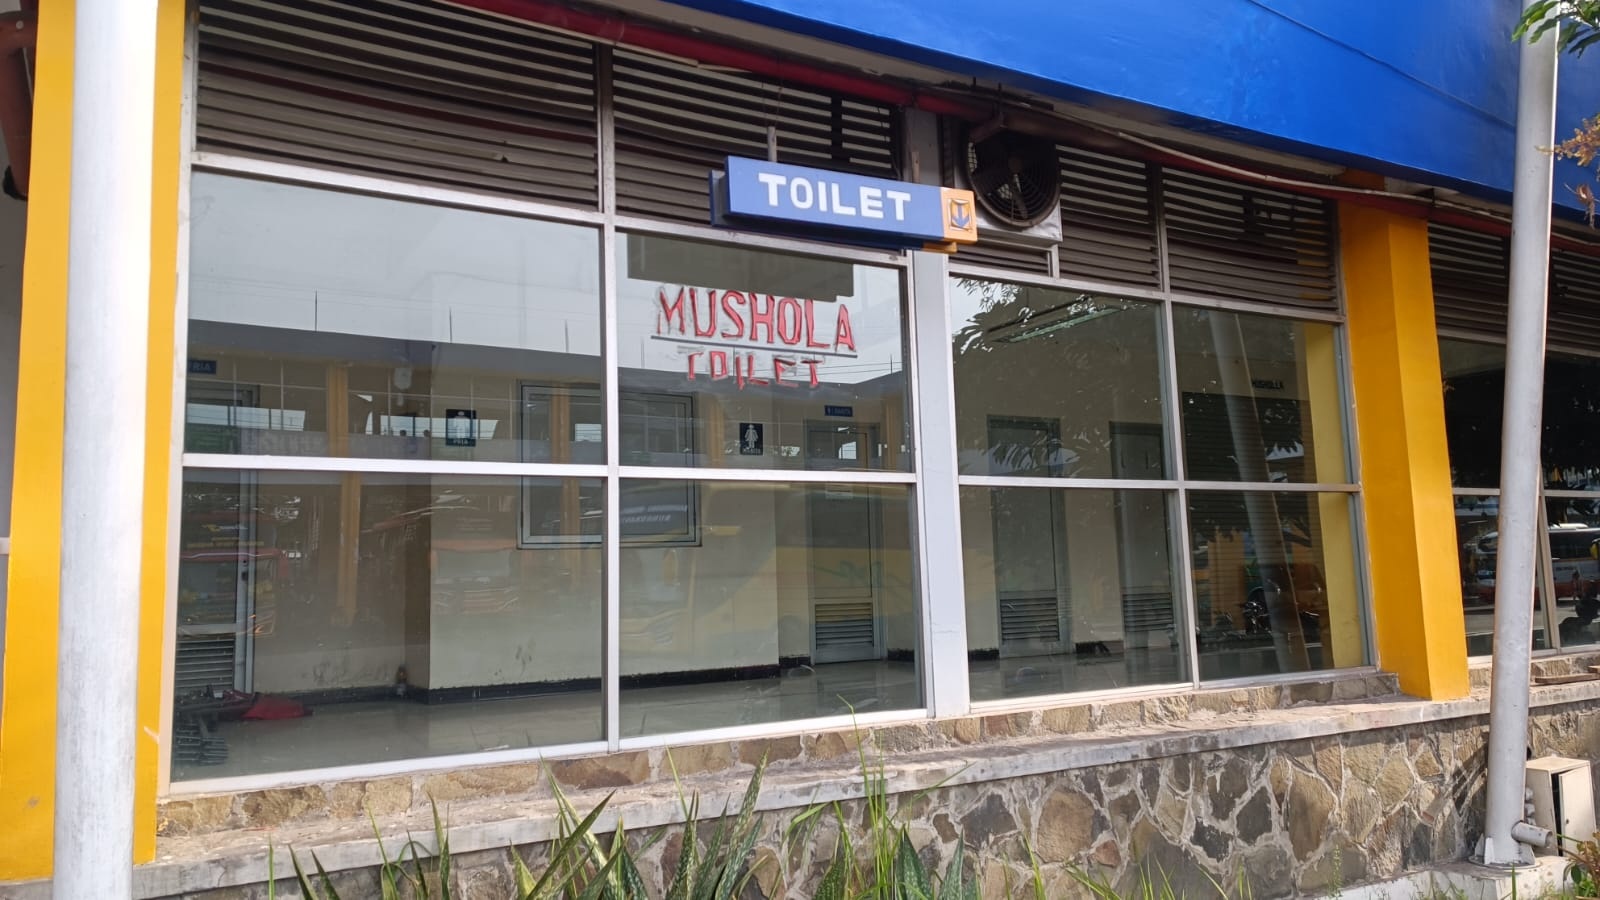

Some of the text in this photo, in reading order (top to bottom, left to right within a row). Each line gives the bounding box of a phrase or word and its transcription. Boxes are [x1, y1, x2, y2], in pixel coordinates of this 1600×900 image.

[758, 172, 911, 221] TOILET
[656, 285, 857, 352] MUSHOLA
[682, 349, 826, 390] TOILET
